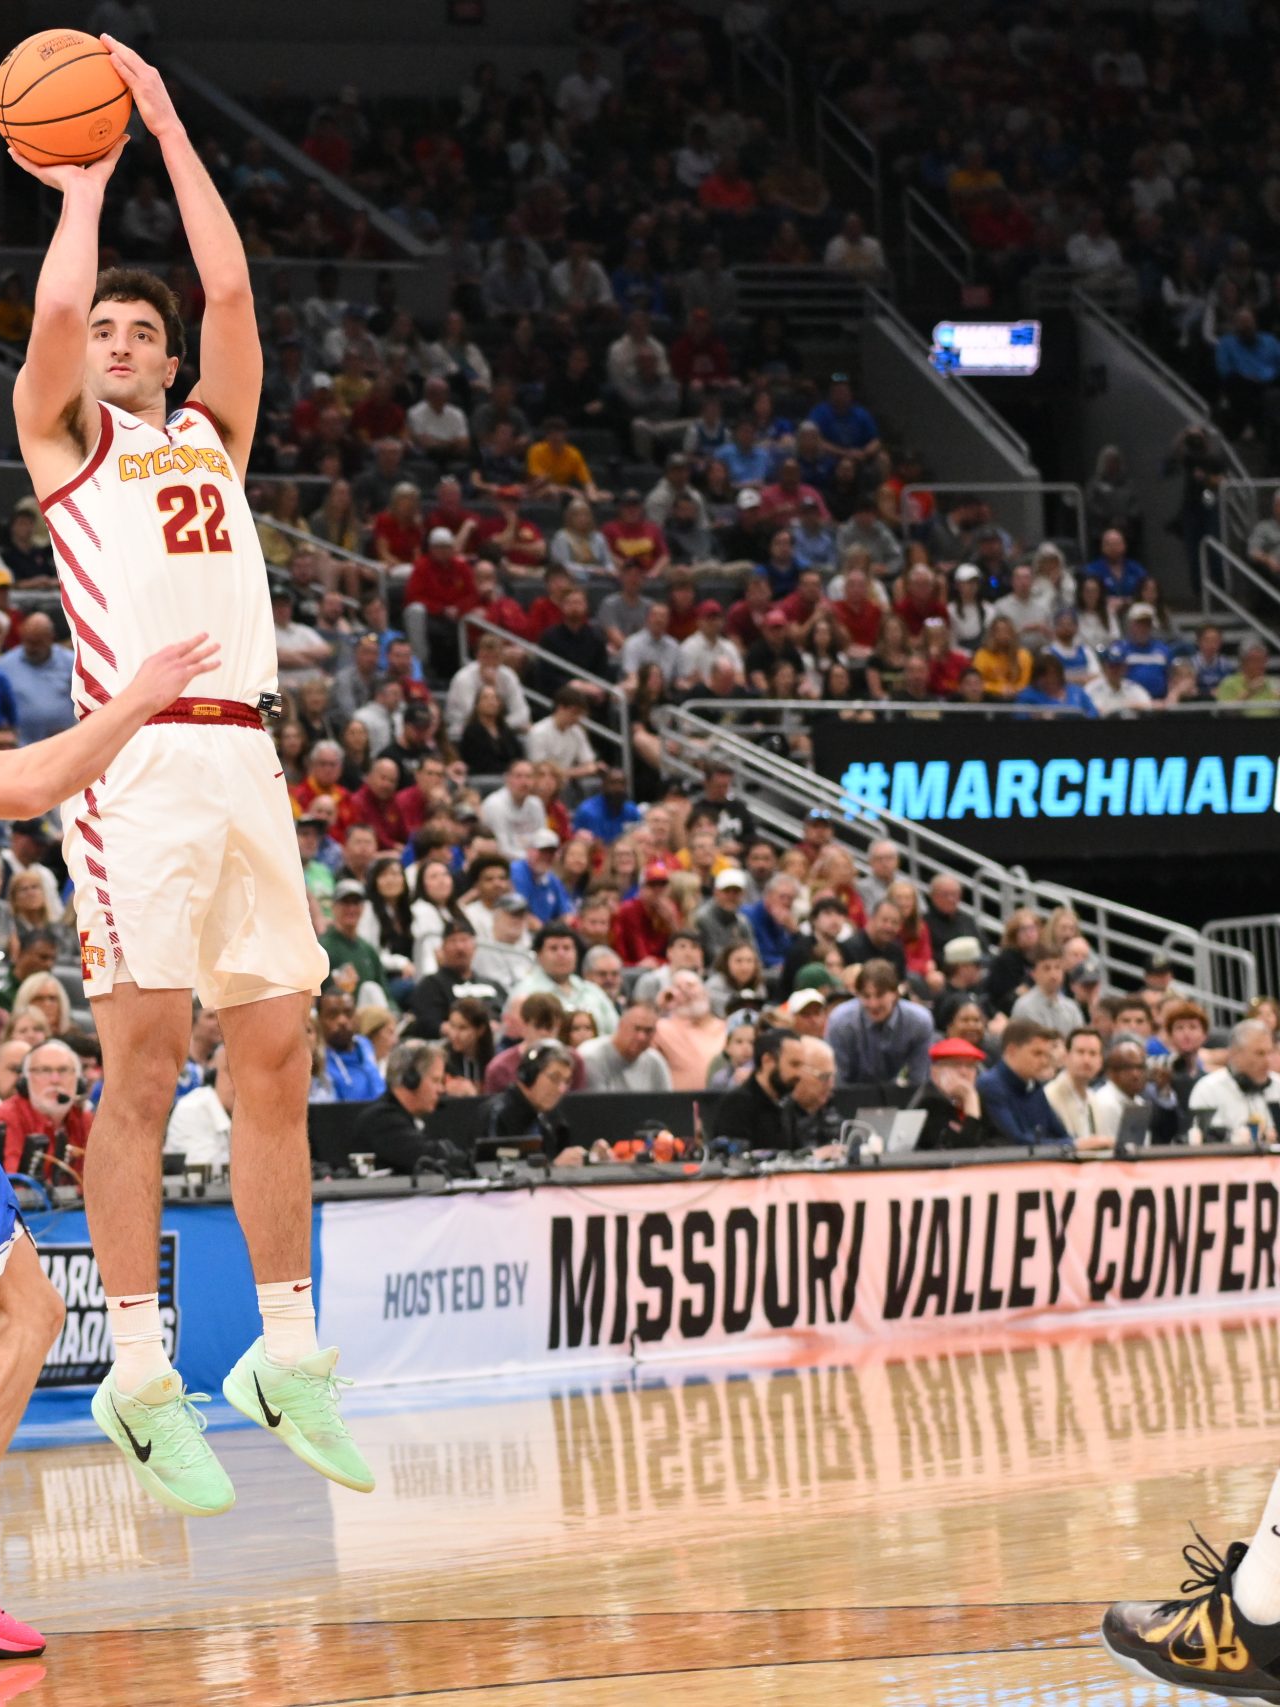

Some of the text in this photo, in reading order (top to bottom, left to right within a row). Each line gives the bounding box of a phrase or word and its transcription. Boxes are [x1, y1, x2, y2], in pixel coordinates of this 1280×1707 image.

[157, 483, 233, 554] 22
[839, 755, 1280, 820] #MARCHMAD
[383, 1261, 528, 1320] HOSTED BY
[548, 1200, 867, 1349] MISSOURI
[882, 1189, 1076, 1320] VALLEY
